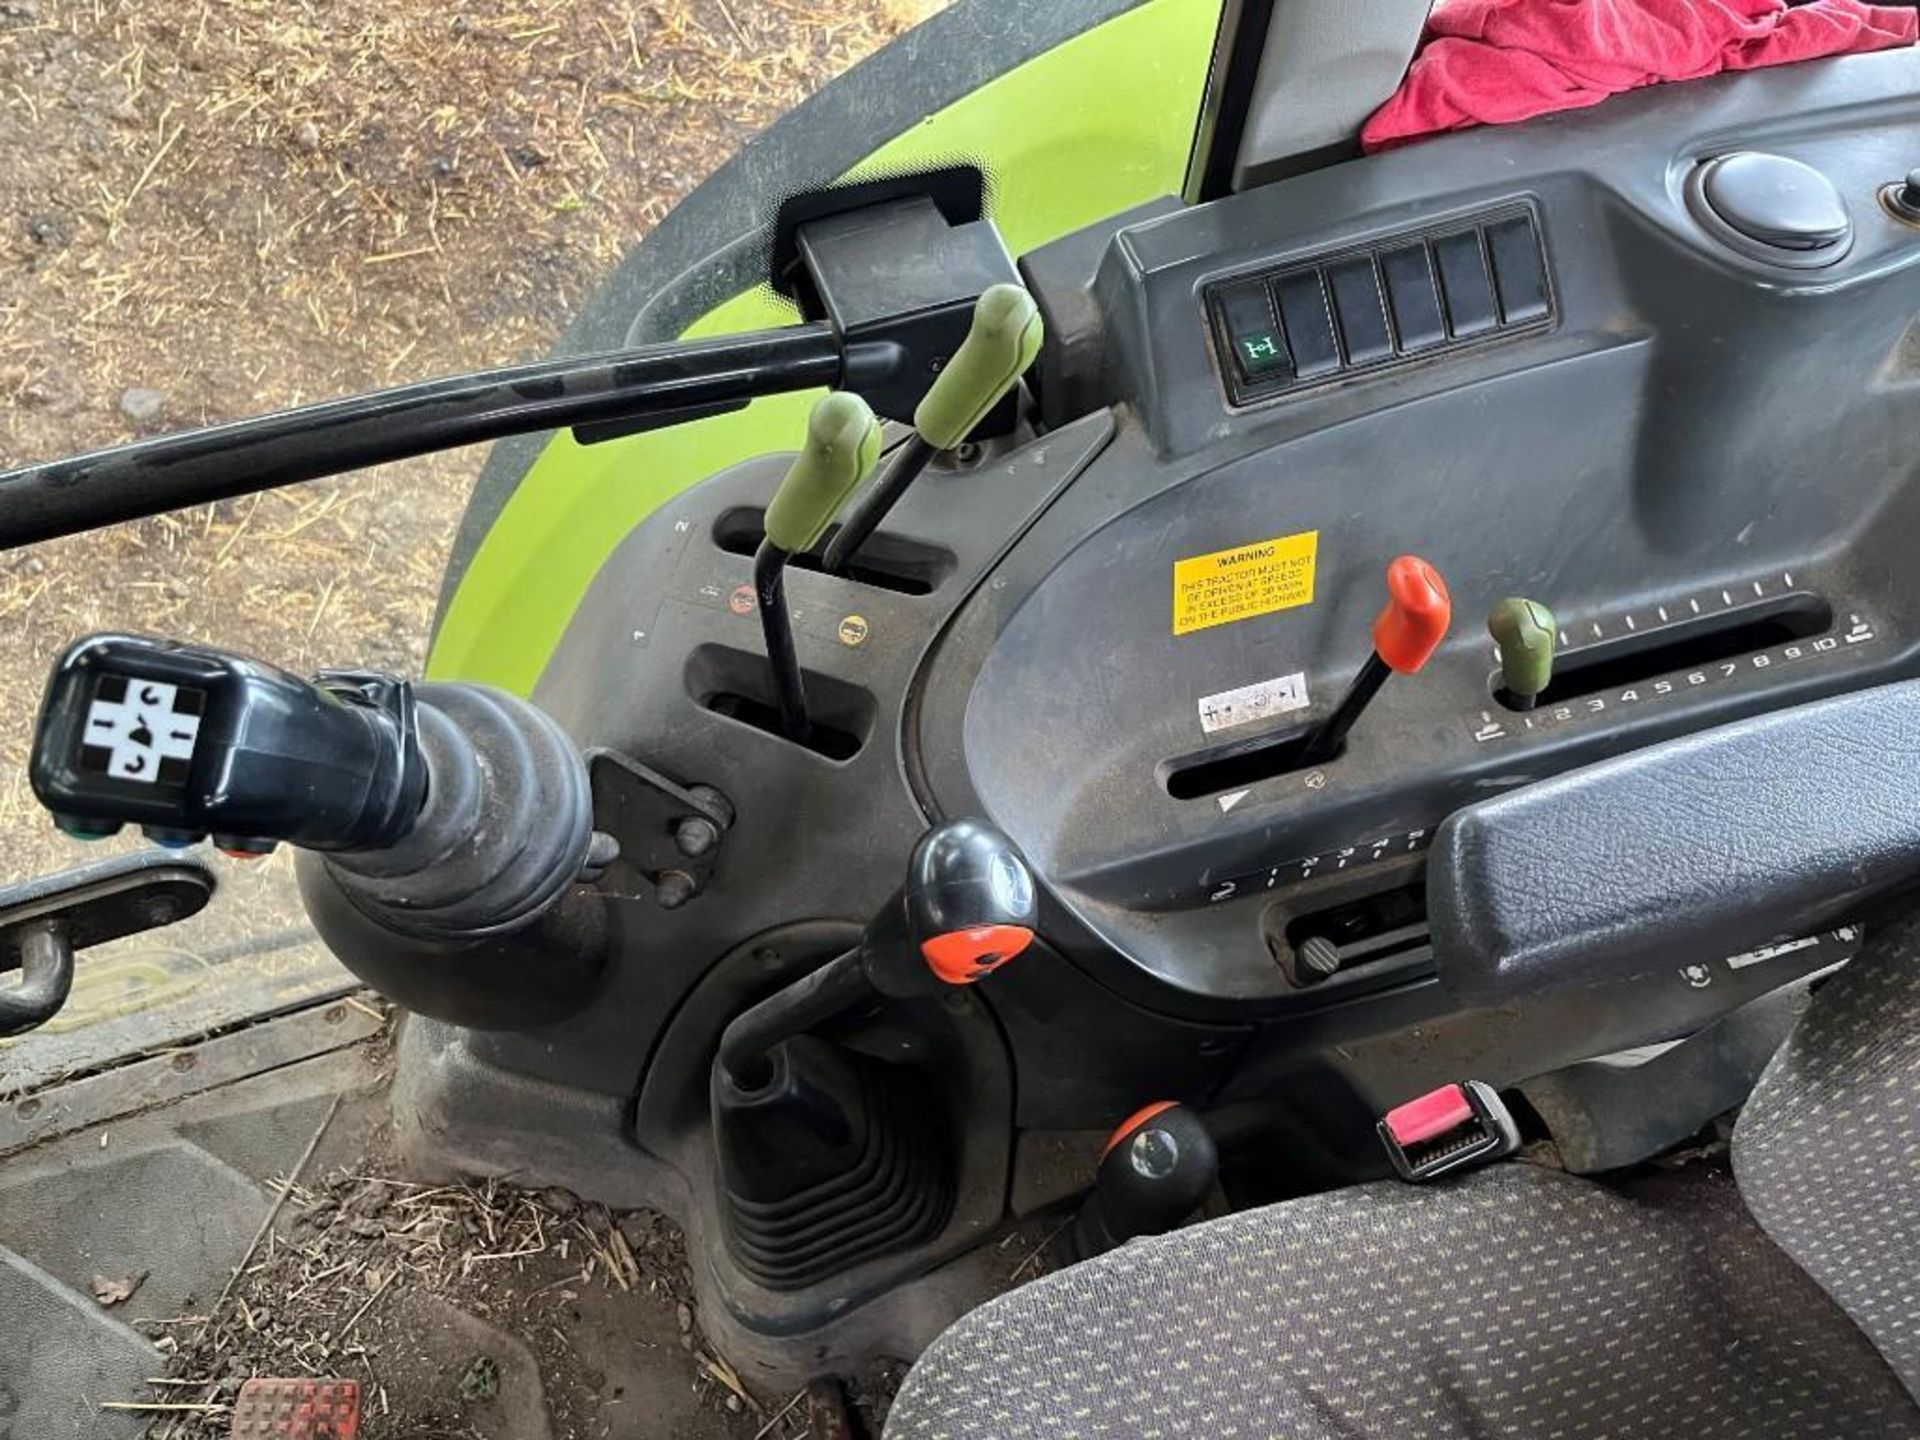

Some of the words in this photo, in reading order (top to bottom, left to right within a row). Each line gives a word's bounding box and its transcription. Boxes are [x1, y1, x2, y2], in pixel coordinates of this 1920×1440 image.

[1217, 546, 1275, 568] WARNING
[1182, 580, 1204, 593] THIS
[1206, 569, 1256, 587] TRACTOR
[1258, 561, 1286, 576] MUST
[1290, 556, 1312, 568] NOT
[1204, 583, 1243, 598] DRIVEN
[1261, 569, 1303, 585] SPEEDS
[1179, 615, 1196, 627] ON
[1199, 609, 1218, 622] THE
[1220, 601, 1258, 617] PUBLIC
[1259, 588, 1308, 607] HIGHWAY
[1200, 593, 1243, 611] EXCESS
[1524, 717, 1534, 730] 1
[1554, 706, 1573, 721] 2
[1587, 698, 1605, 713] 3
[1621, 689, 1639, 702] 4
[1654, 680, 1673, 694] 5
[1687, 671, 1707, 685] 6
[1720, 662, 1737, 677] 7
[1752, 654, 1771, 668] 8
[1784, 646, 1802, 660] 9
[1812, 637, 1838, 652] 10
